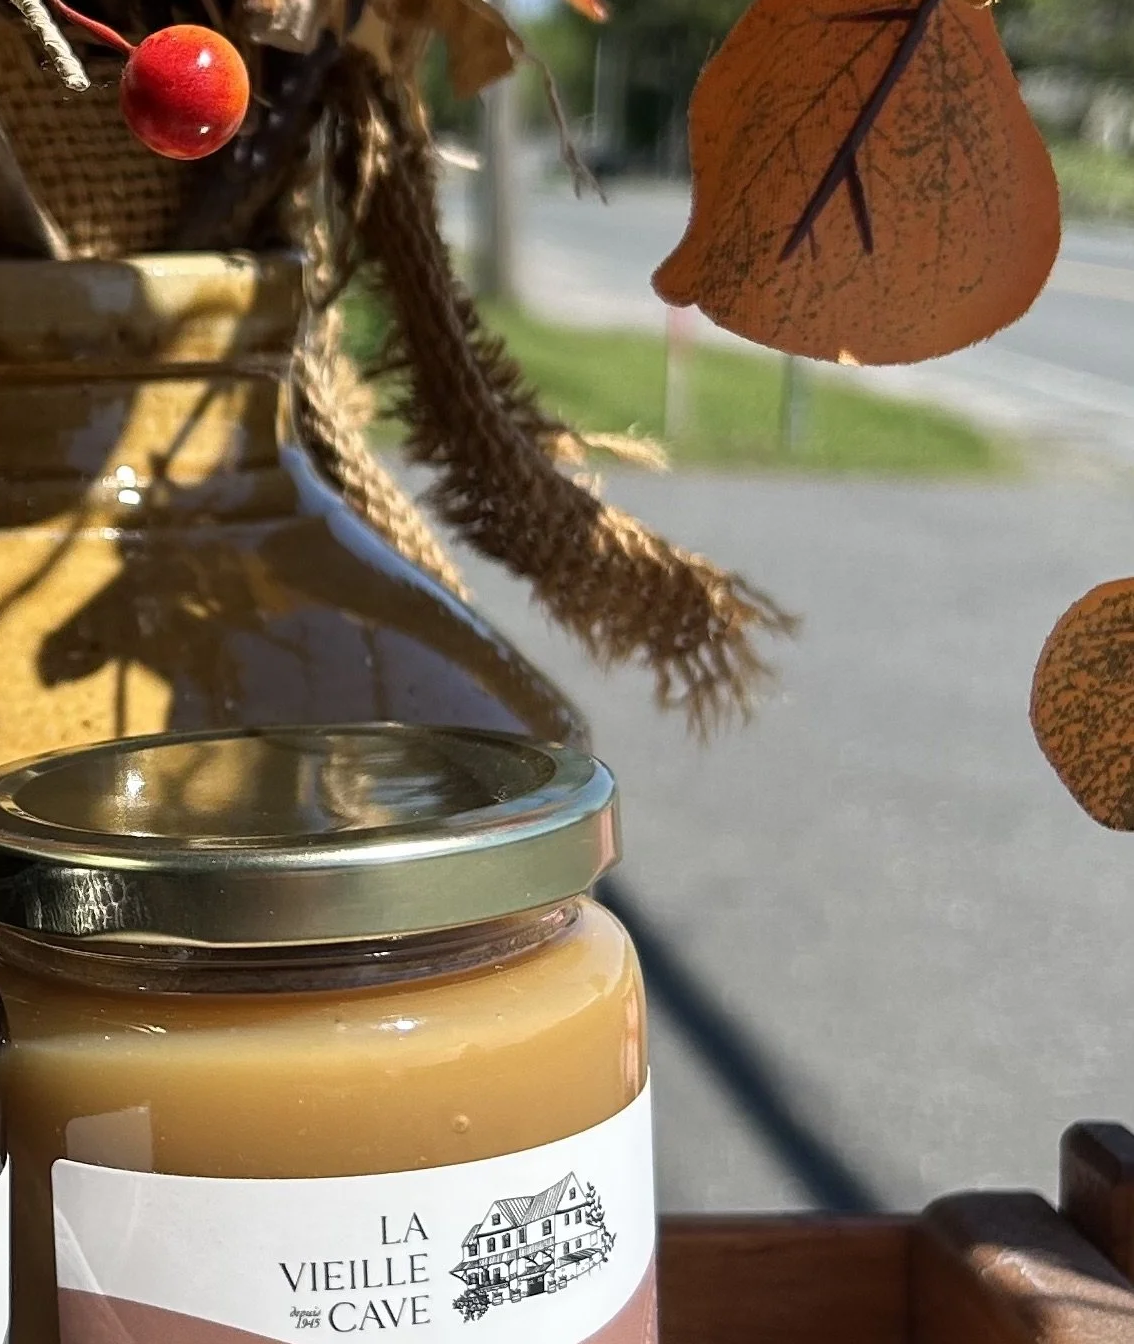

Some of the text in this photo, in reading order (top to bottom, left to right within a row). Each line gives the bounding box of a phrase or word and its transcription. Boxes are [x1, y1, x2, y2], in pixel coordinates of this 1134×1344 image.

[380, 1212, 429, 1245] LA
[278, 1253, 430, 1292] VIEILLE
[289, 1306, 322, 1318] depuis
[295, 1318, 321, 1329] 1945
[328, 1294, 431, 1333] CAVE
